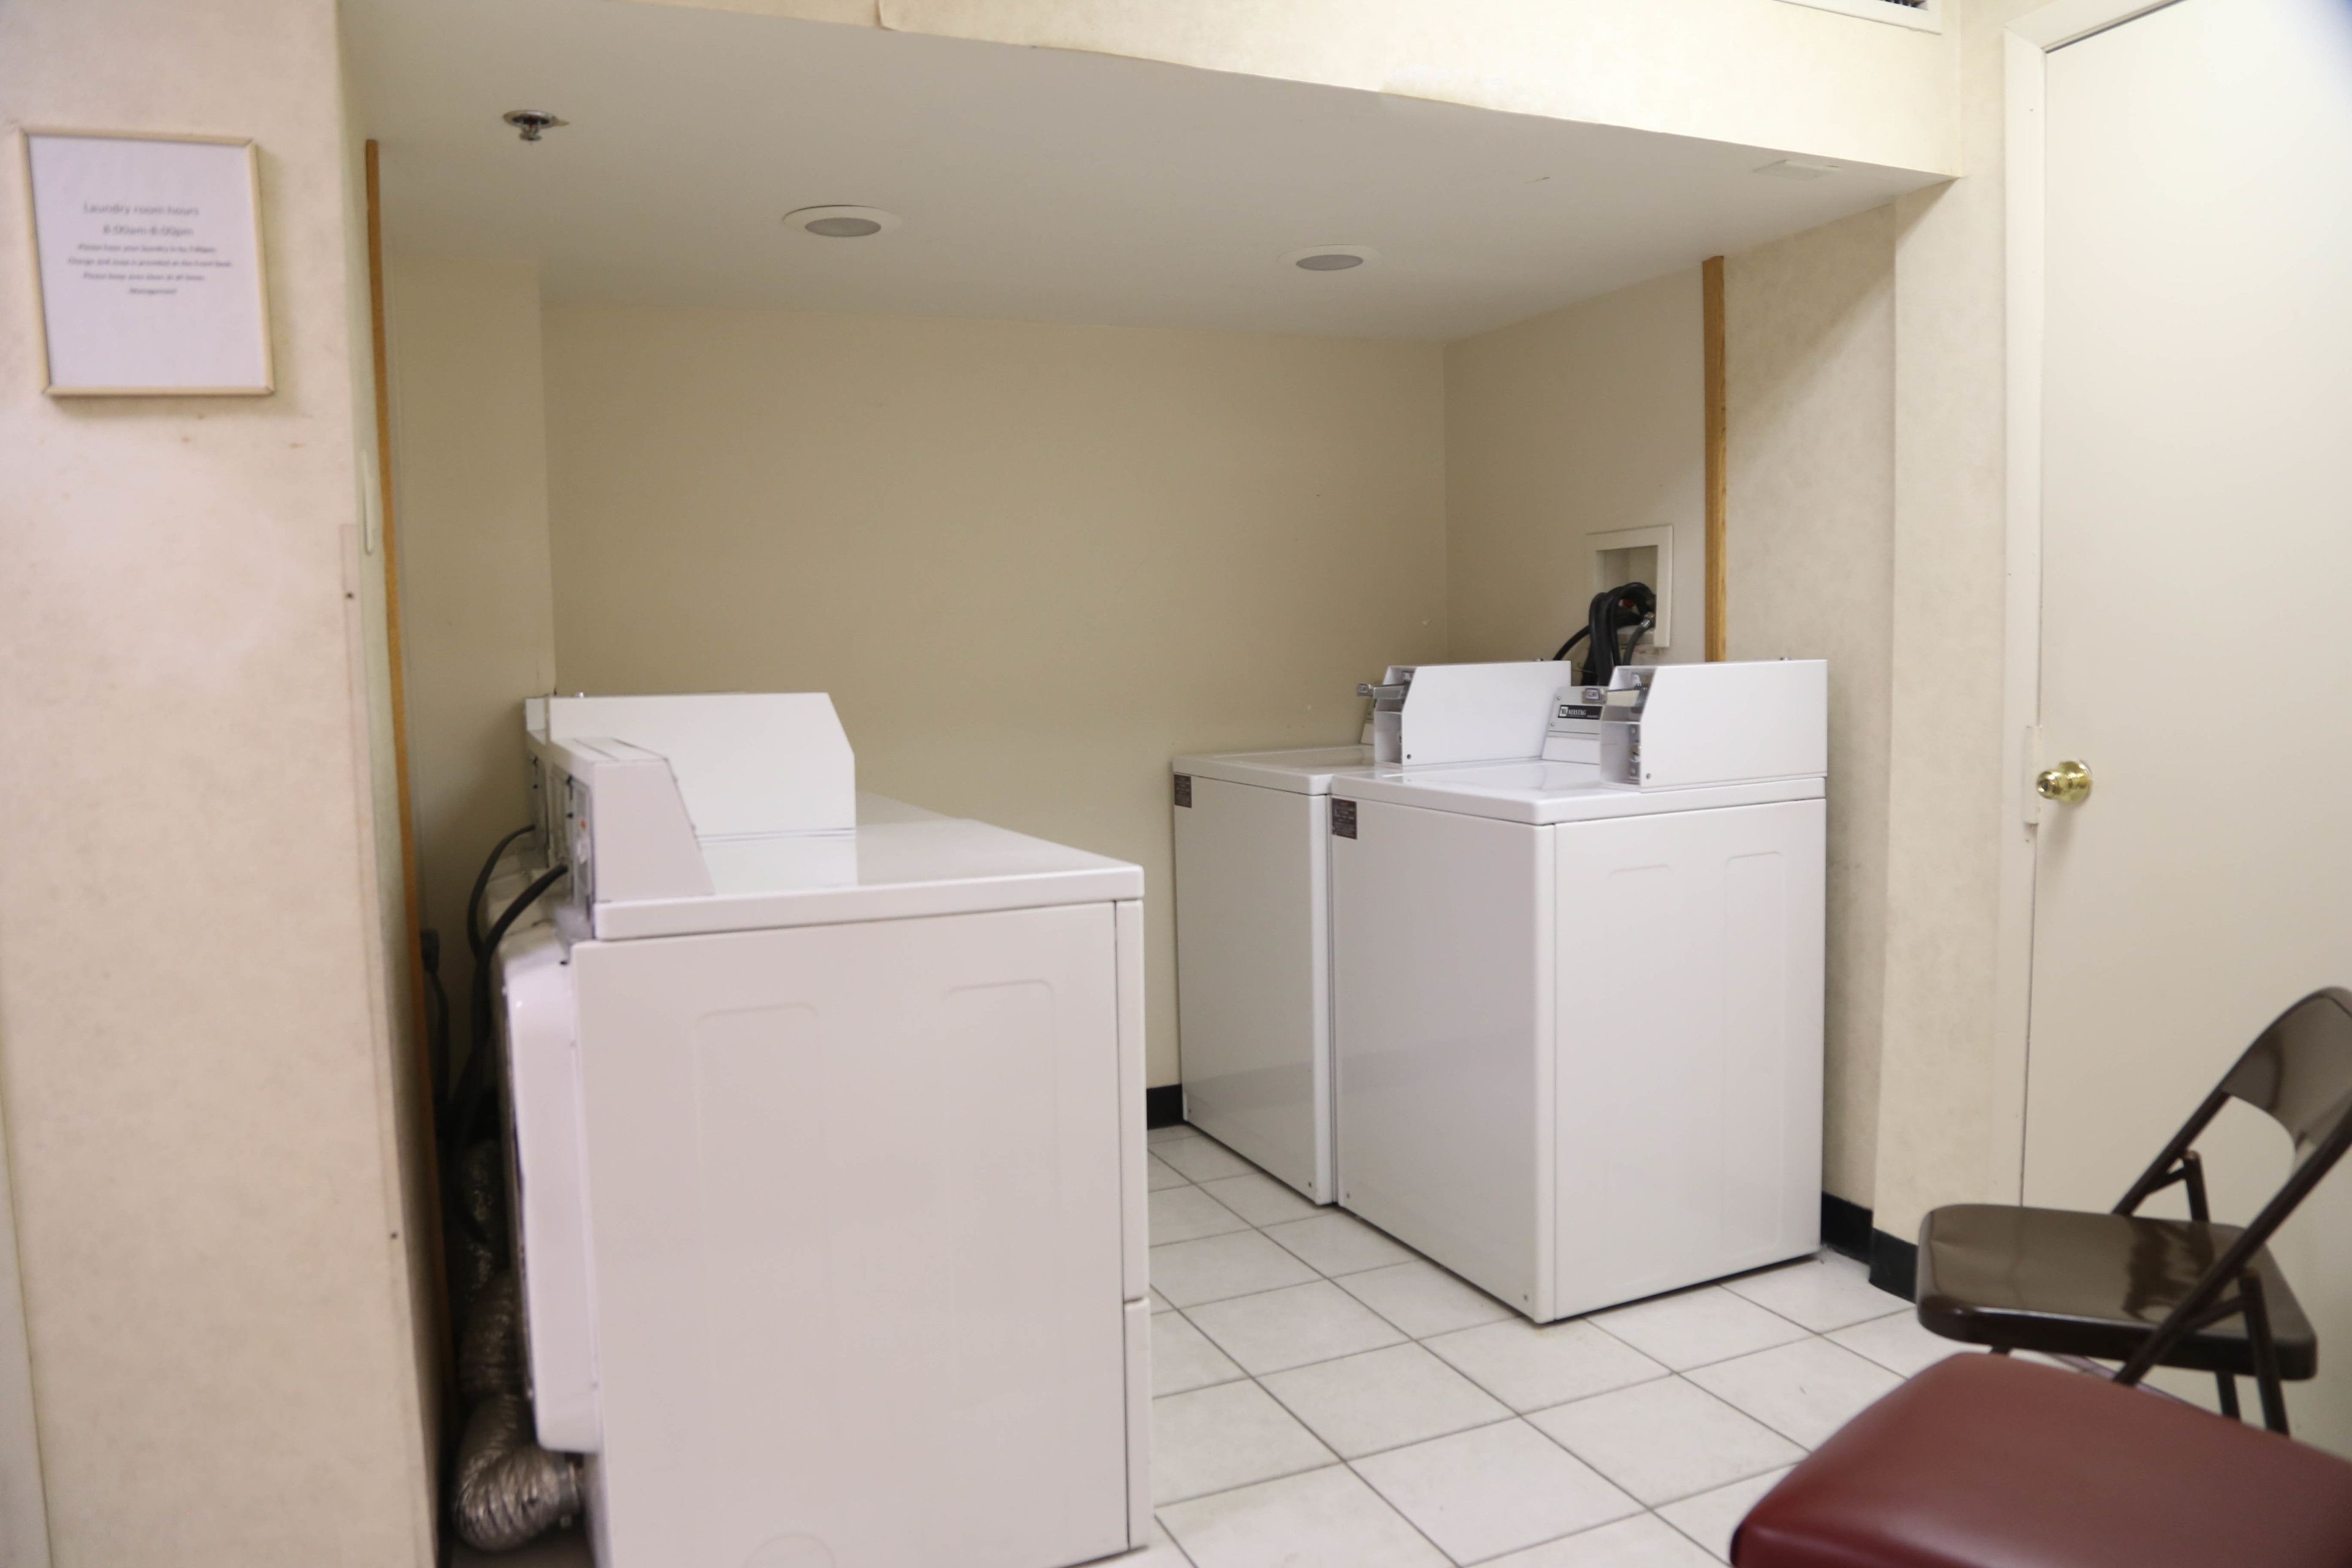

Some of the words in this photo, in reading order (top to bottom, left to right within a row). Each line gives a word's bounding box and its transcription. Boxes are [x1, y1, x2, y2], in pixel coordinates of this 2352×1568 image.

[83, 202, 130, 215] Laundry
[134, 206, 164, 214] room
[167, 205, 199, 216] hours
